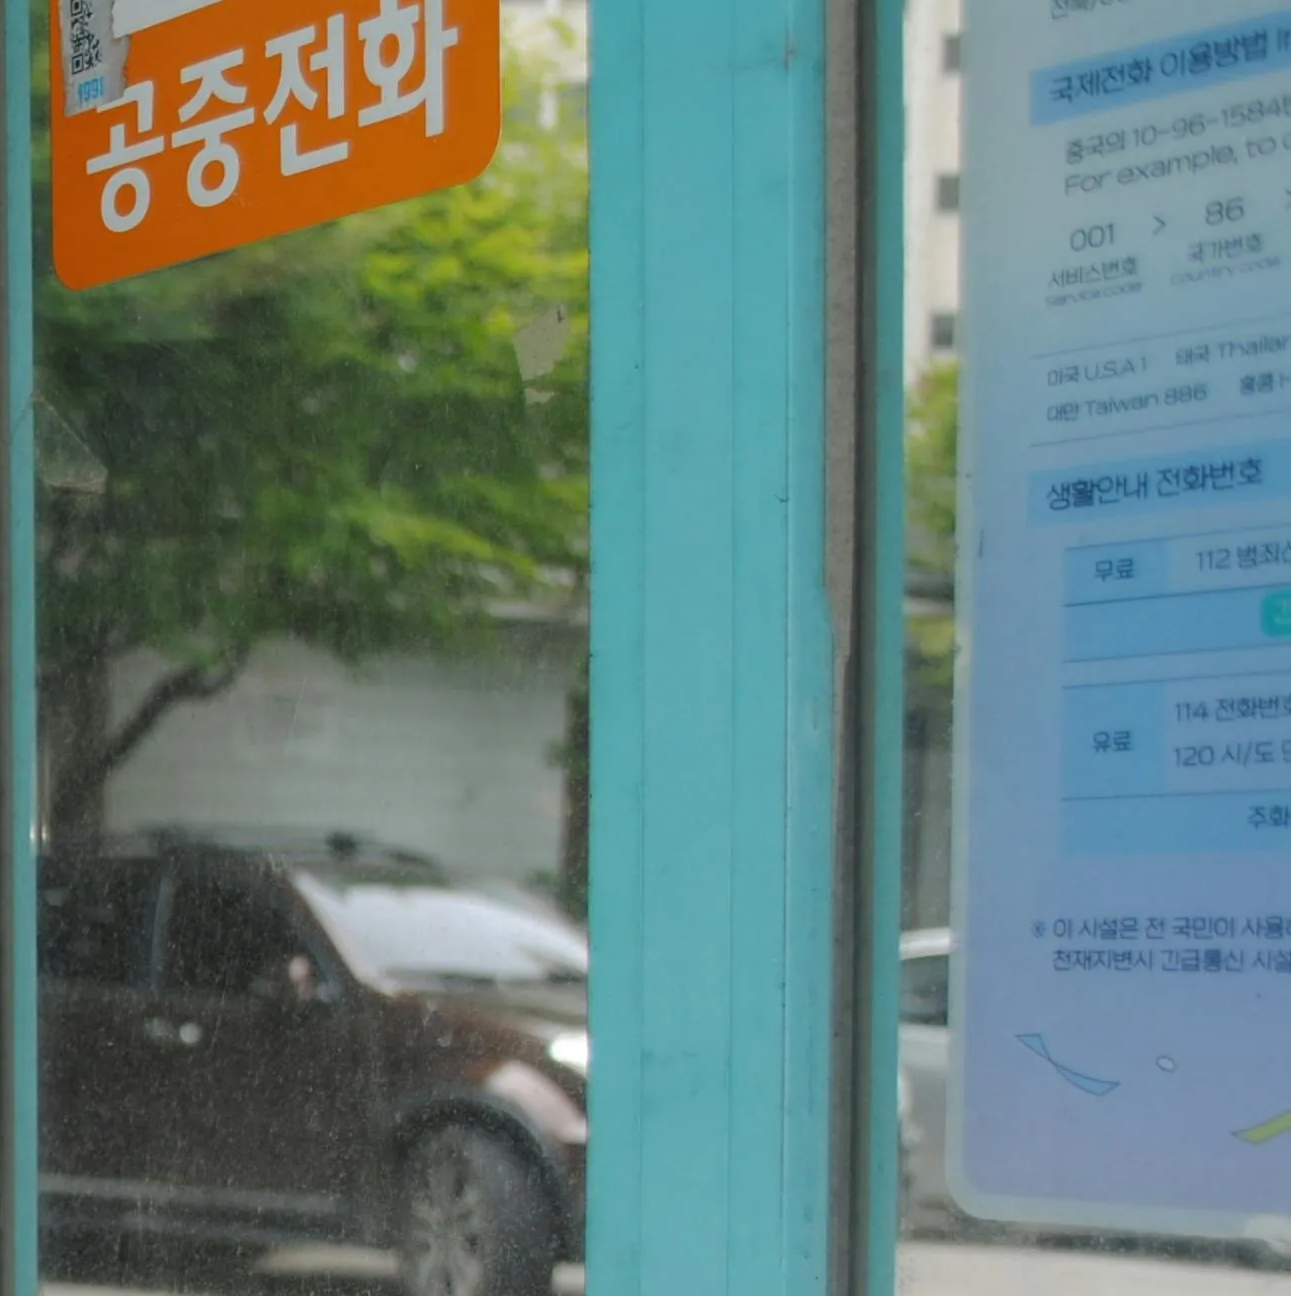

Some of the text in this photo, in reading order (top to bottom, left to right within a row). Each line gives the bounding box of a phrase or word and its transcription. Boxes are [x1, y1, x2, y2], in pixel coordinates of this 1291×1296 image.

[1050, 56, 1153, 103] 국제전화
[86, 0, 459, 233] 공중전화
[1064, 169, 1113, 197] For
[1244, 134, 1276, 159] to
[1204, 196, 1245, 227] 86
[1070, 223, 1116, 253] 001
[1085, 392, 1159, 417] Taiwan
[1046, 456, 1266, 512] 생활안내 전화번호
[1094, 557, 1136, 583] 무료
[1195, 547, 1231, 573] 112
[1175, 702, 1209, 722] 114
[1092, 729, 1132, 754] 유료
[1174, 745, 1215, 768] 120
[1053, 917, 1072, 940] 이
[1079, 917, 1139, 941] 시설은
[1145, 917, 1165, 940] 전
[1172, 916, 1235, 940] 국민이
[1053, 948, 1153, 972] 천재지변시
